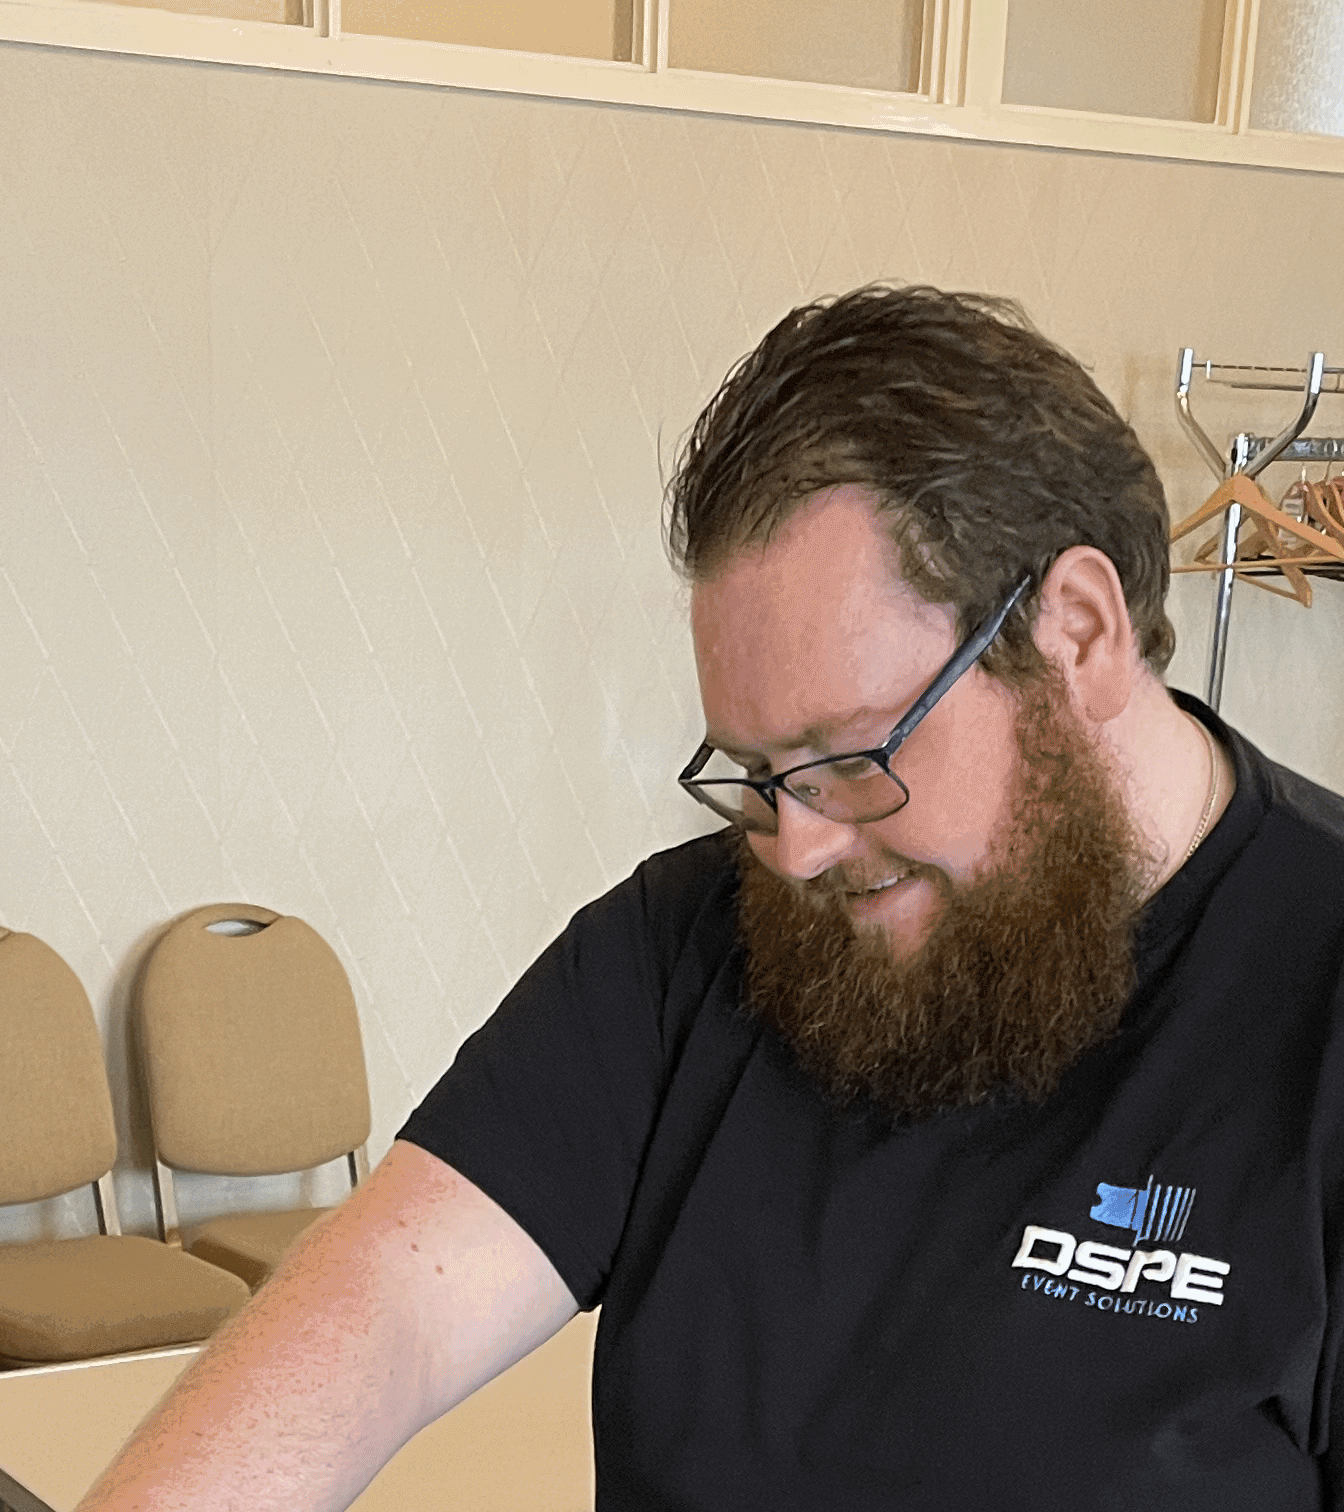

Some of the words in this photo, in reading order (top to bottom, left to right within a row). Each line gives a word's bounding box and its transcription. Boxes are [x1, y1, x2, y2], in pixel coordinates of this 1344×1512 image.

[1011, 1225, 1230, 1306] DSPE
[1021, 1274, 1080, 1301] EVENT
[1085, 1292, 1198, 1324] SOLUTIONS
